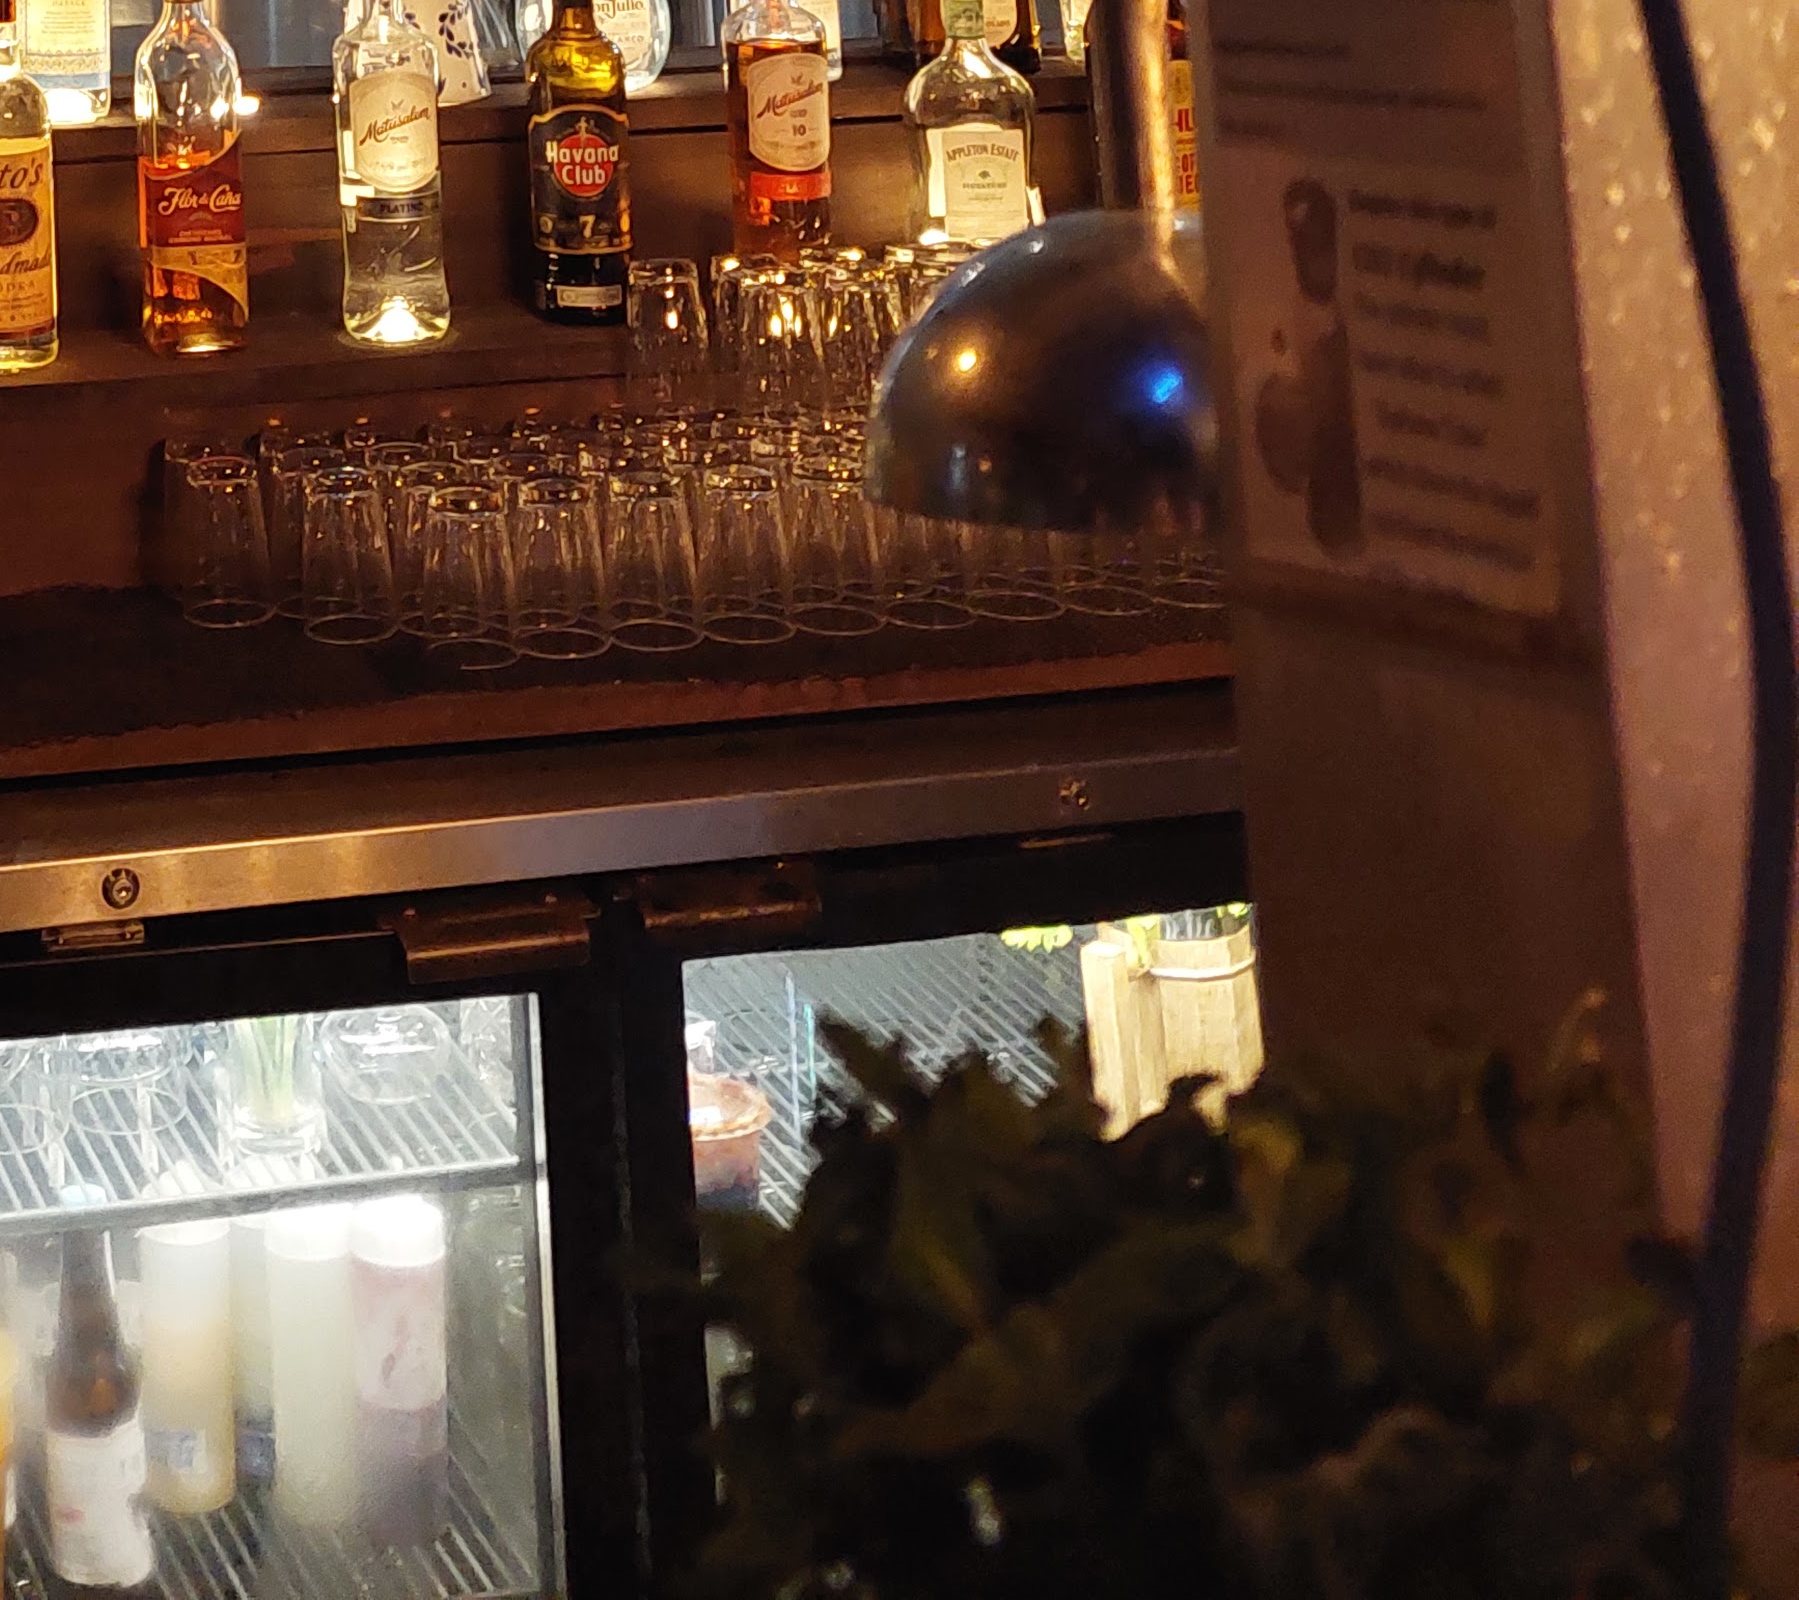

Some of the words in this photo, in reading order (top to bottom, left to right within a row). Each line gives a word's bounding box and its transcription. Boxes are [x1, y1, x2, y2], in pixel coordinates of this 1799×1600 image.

[358, 104, 432, 147] Matusalem
[792, 123, 807, 137] 10
[545, 140, 620, 164] Havana
[945, 144, 989, 162] APPLETON
[561, 164, 606, 186] Club
[158, 186, 199, 216] Flor
[209, 183, 242, 213] Caña
[578, 214, 596, 239] 7
